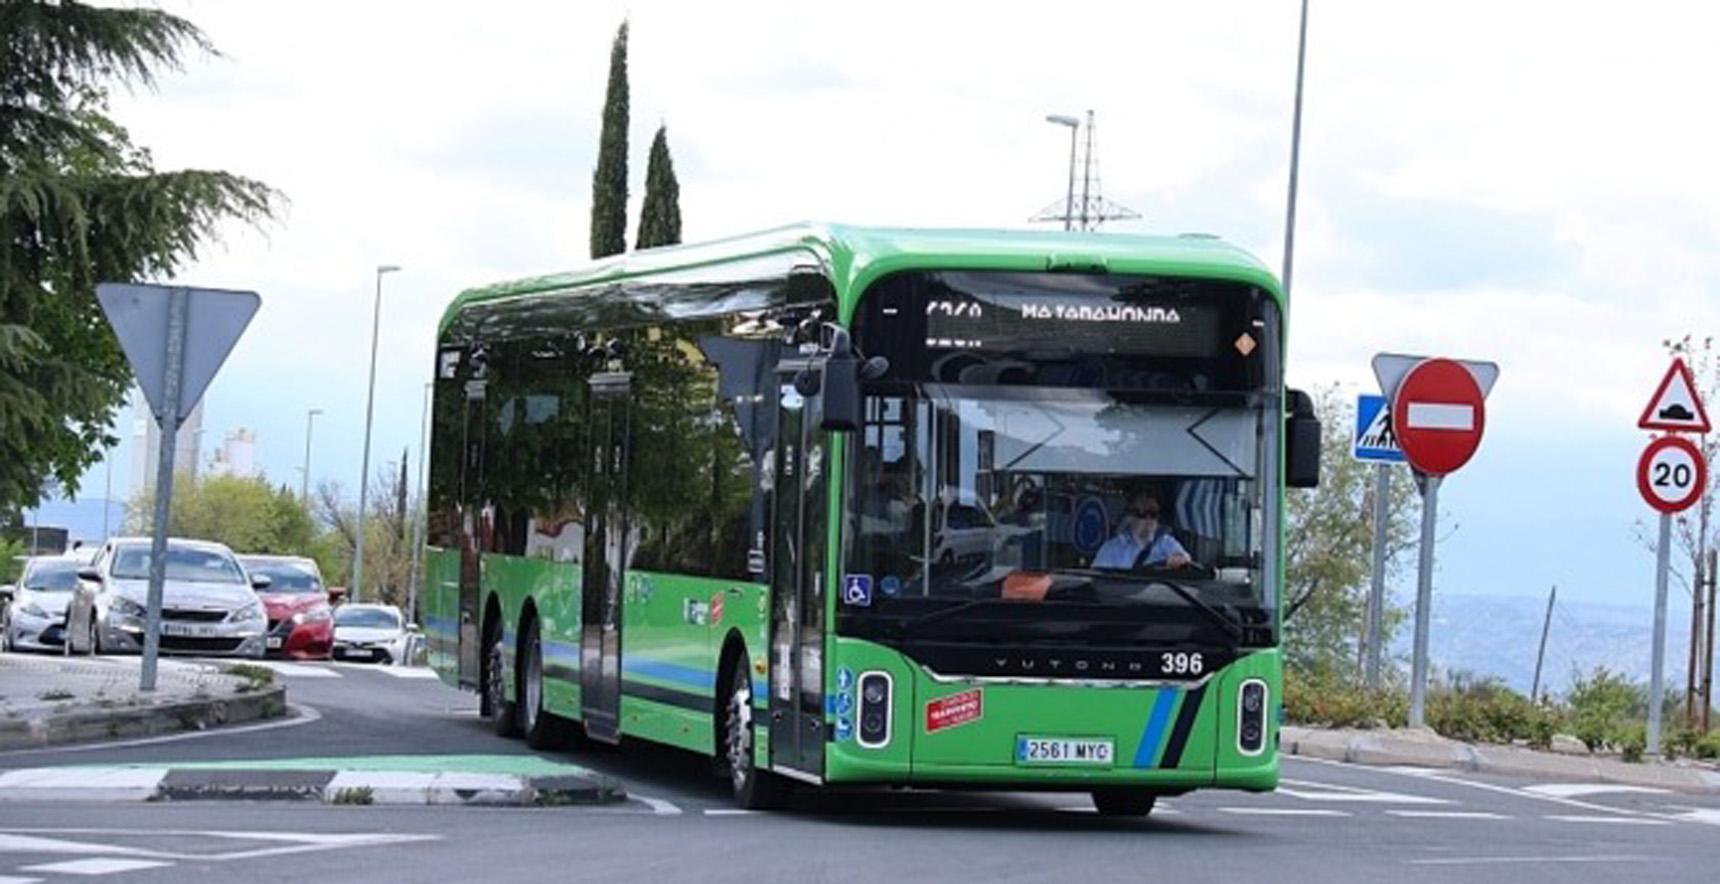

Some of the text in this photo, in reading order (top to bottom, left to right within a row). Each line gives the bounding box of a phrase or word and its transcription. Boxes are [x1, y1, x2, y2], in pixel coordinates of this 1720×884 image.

[1654, 462, 1691, 488] 20
[1161, 653, 1203, 673] 396
[1029, 742, 1069, 759] 2561
